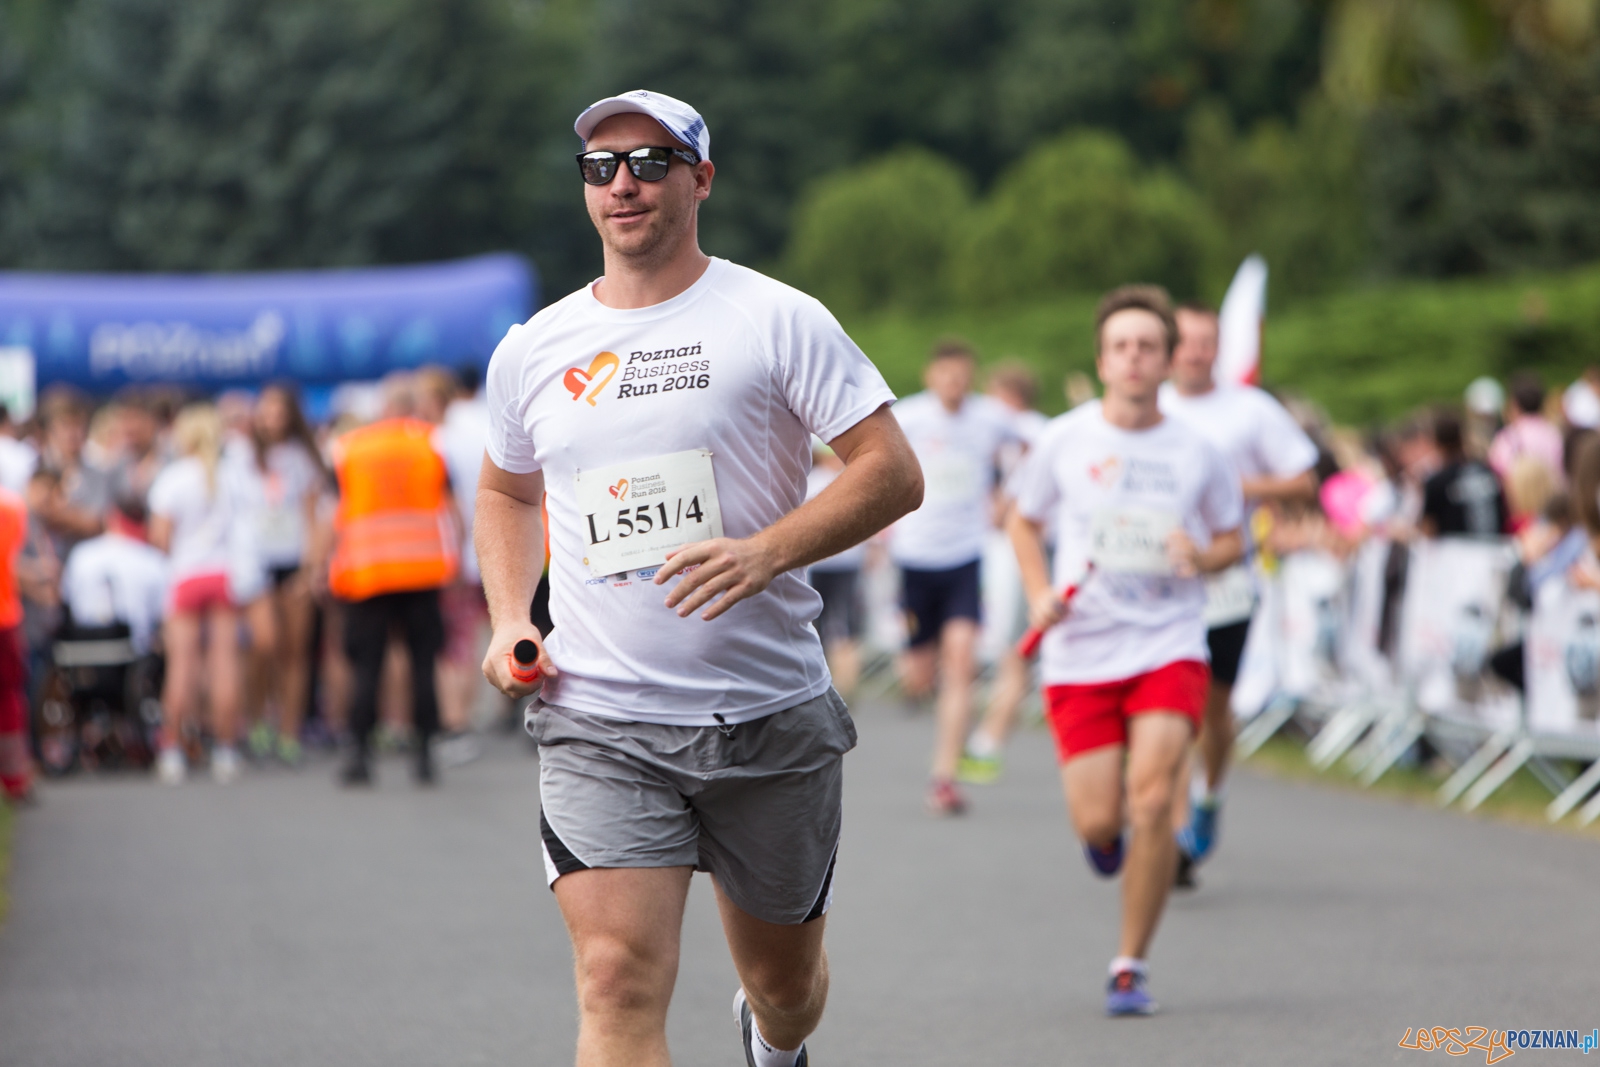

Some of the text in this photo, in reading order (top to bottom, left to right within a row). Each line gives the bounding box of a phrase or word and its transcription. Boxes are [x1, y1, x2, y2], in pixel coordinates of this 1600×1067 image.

[627, 341, 703, 365] Poznań
[621, 360, 710, 382] Business
[617, 374, 711, 399] Run 2016
[631, 473, 661, 484] Poznań
[631, 480, 666, 491] Business
[631, 486, 667, 499] Run 2016
[585, 512, 611, 546] L
[616, 495, 704, 538] 551/4
